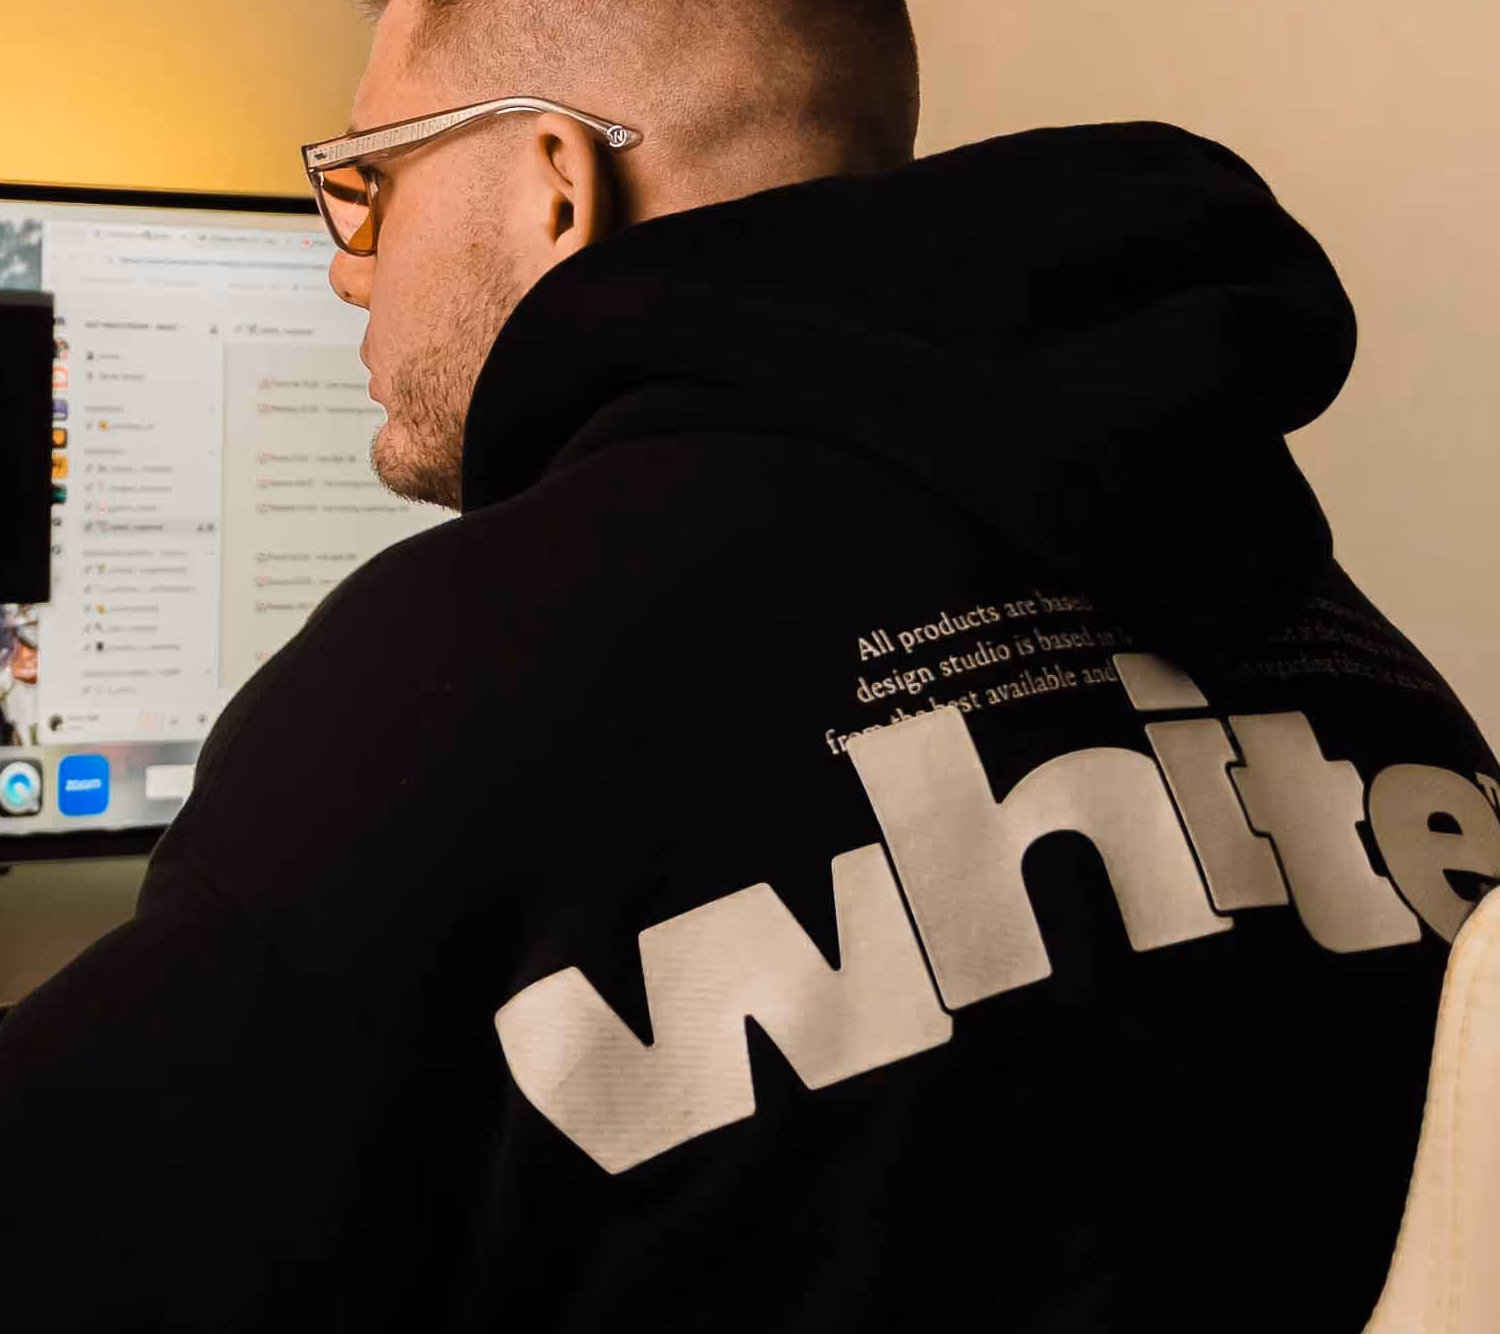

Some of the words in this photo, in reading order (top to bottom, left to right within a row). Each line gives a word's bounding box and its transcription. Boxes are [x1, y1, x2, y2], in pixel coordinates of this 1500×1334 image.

[855, 668, 936, 704] design
[938, 640, 1011, 678] studio
[1016, 634, 1035, 657] is
[1032, 621, 1096, 651] based
[856, 628, 896, 661] All
[897, 604, 1001, 654] products
[1003, 596, 1038, 619] are
[986, 664, 1077, 706] available
[1081, 658, 1118, 684] and
[493, 653, 1500, 1175] white
